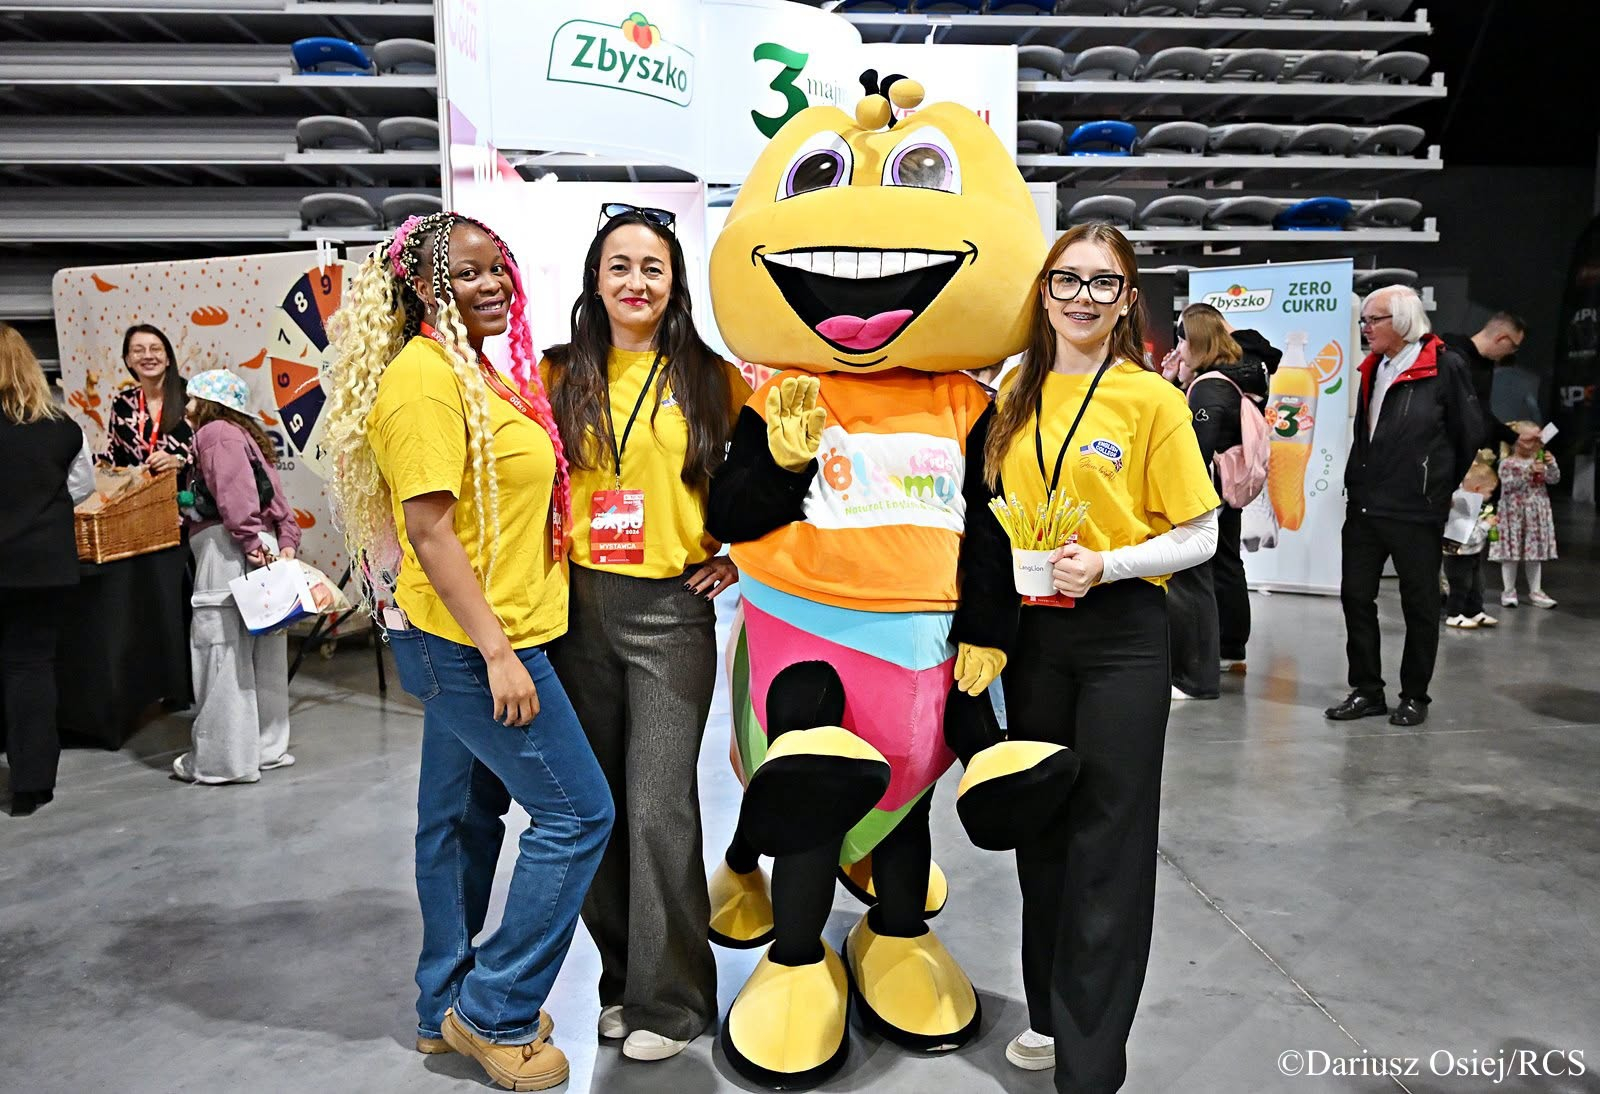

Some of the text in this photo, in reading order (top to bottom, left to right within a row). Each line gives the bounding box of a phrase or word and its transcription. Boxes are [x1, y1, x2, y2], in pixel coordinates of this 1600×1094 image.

[571, 34, 687, 92] Zbyszko
[751, 42, 809, 139] 3
[320, 274, 332, 295] 9
[1288, 281, 1332, 296] ZERO
[294, 291, 309, 313] 8
[1209, 294, 1265, 310] Zbyszko
[1282, 298, 1338, 313] CUKRU
[277, 328, 291, 345] 7
[277, 372, 290, 388] 6
[289, 413, 304, 434] 5
[1275, 405, 1301, 437] 3
[845, 500, 883, 516] Natural
